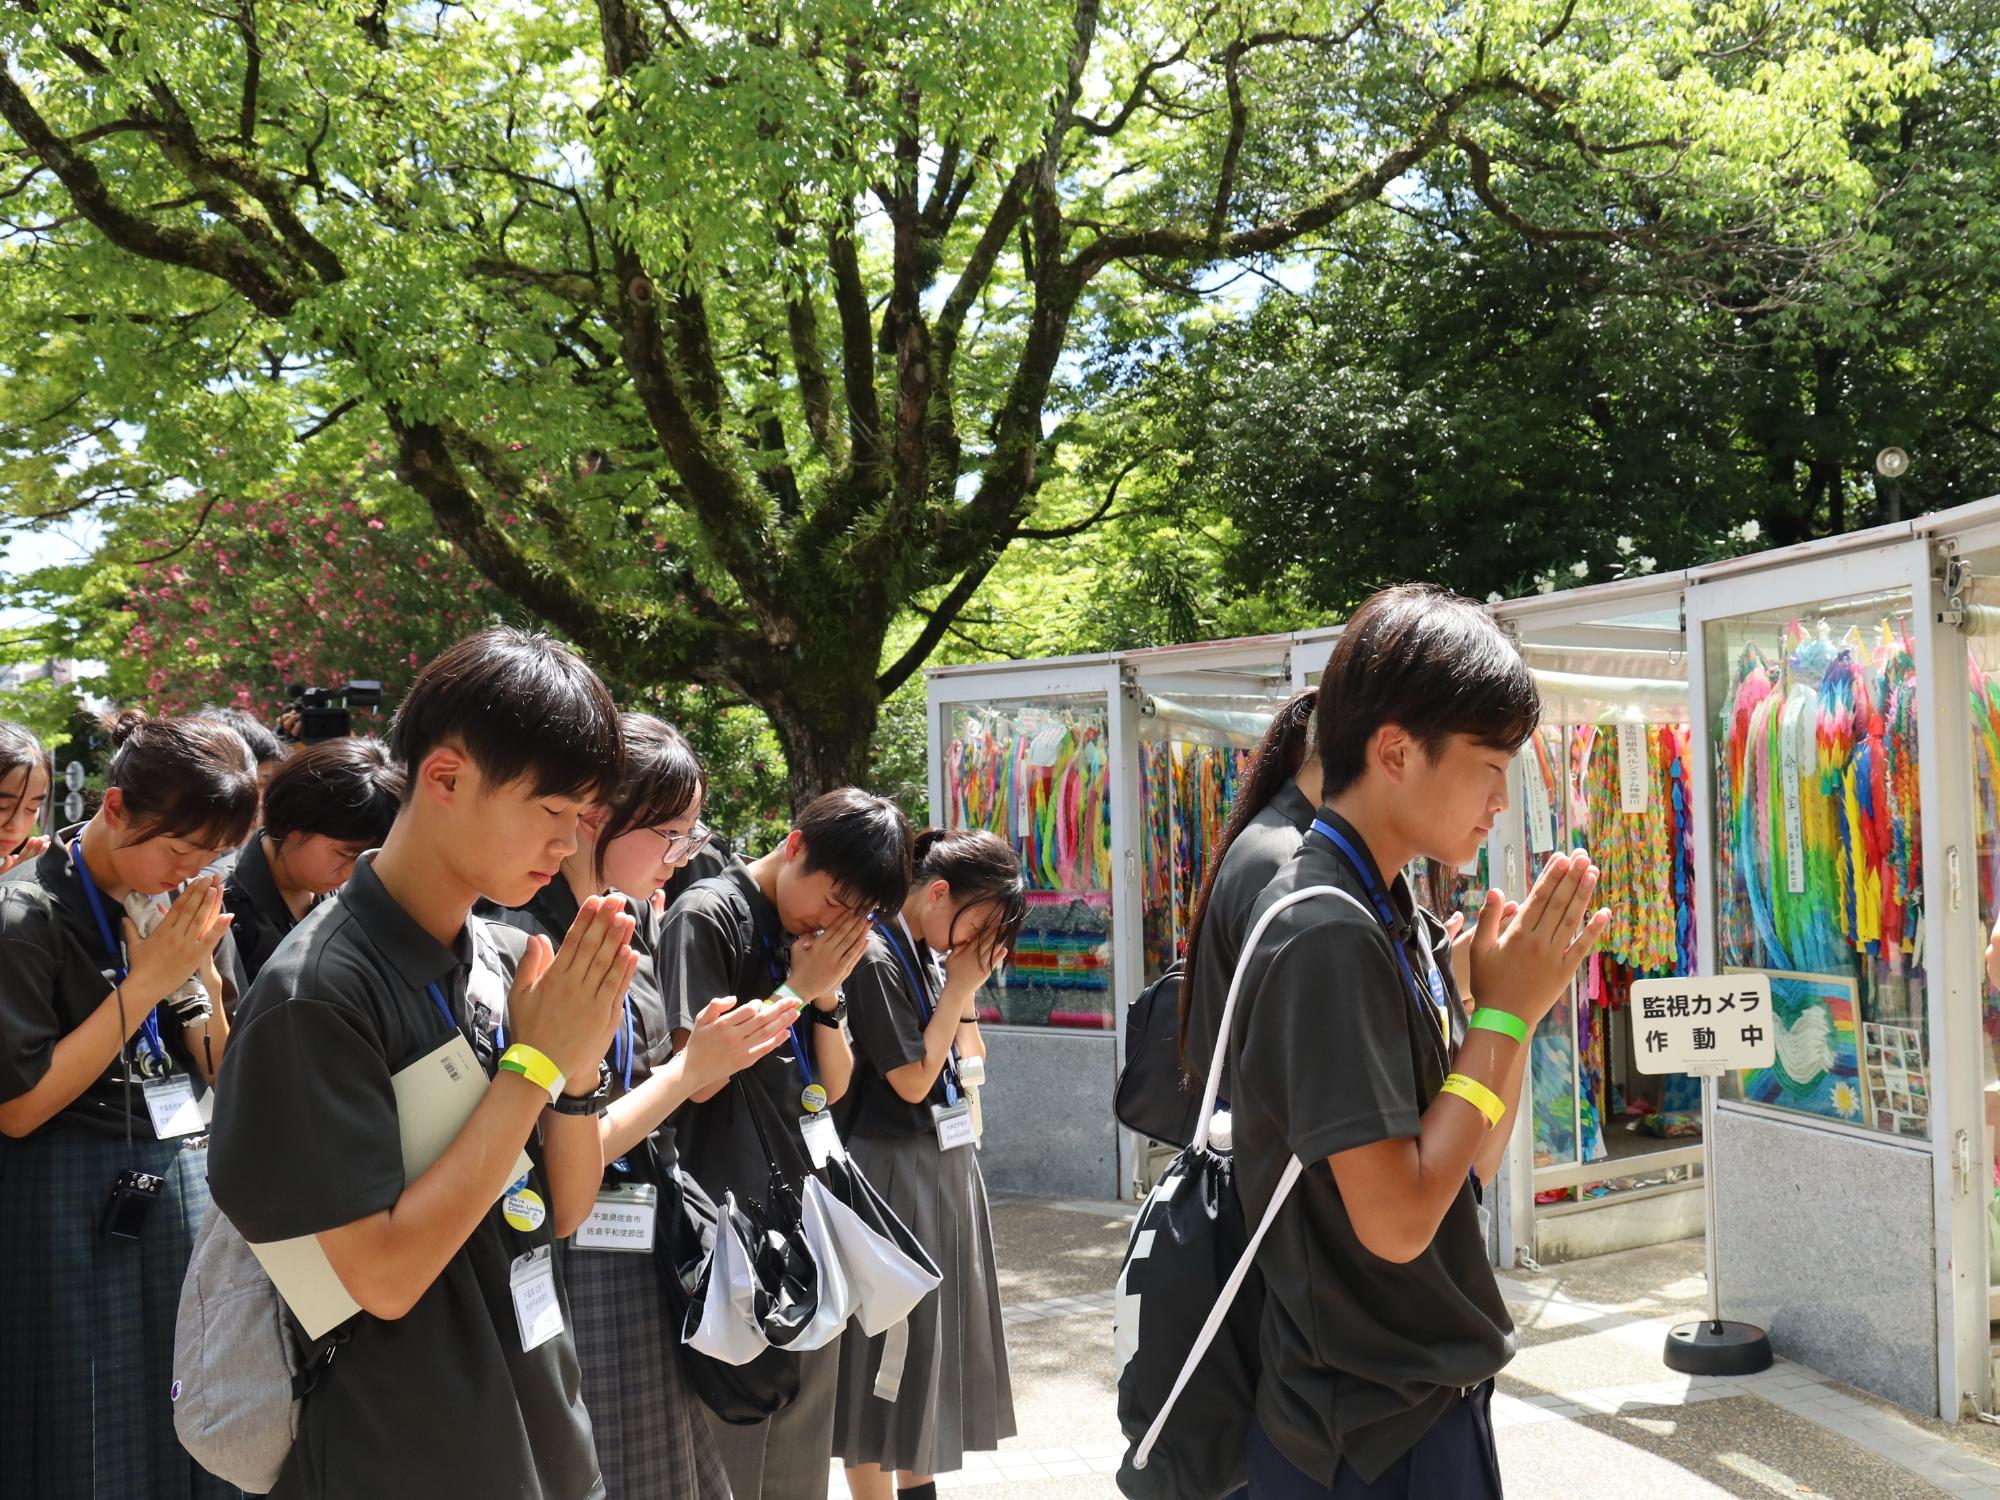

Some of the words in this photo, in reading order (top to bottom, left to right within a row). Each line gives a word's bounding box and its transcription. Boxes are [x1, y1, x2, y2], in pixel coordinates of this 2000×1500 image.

[1643, 991, 1760, 1019] 監視カメラ
[593, 1212, 641, 1223] 千葉県佐倉市
